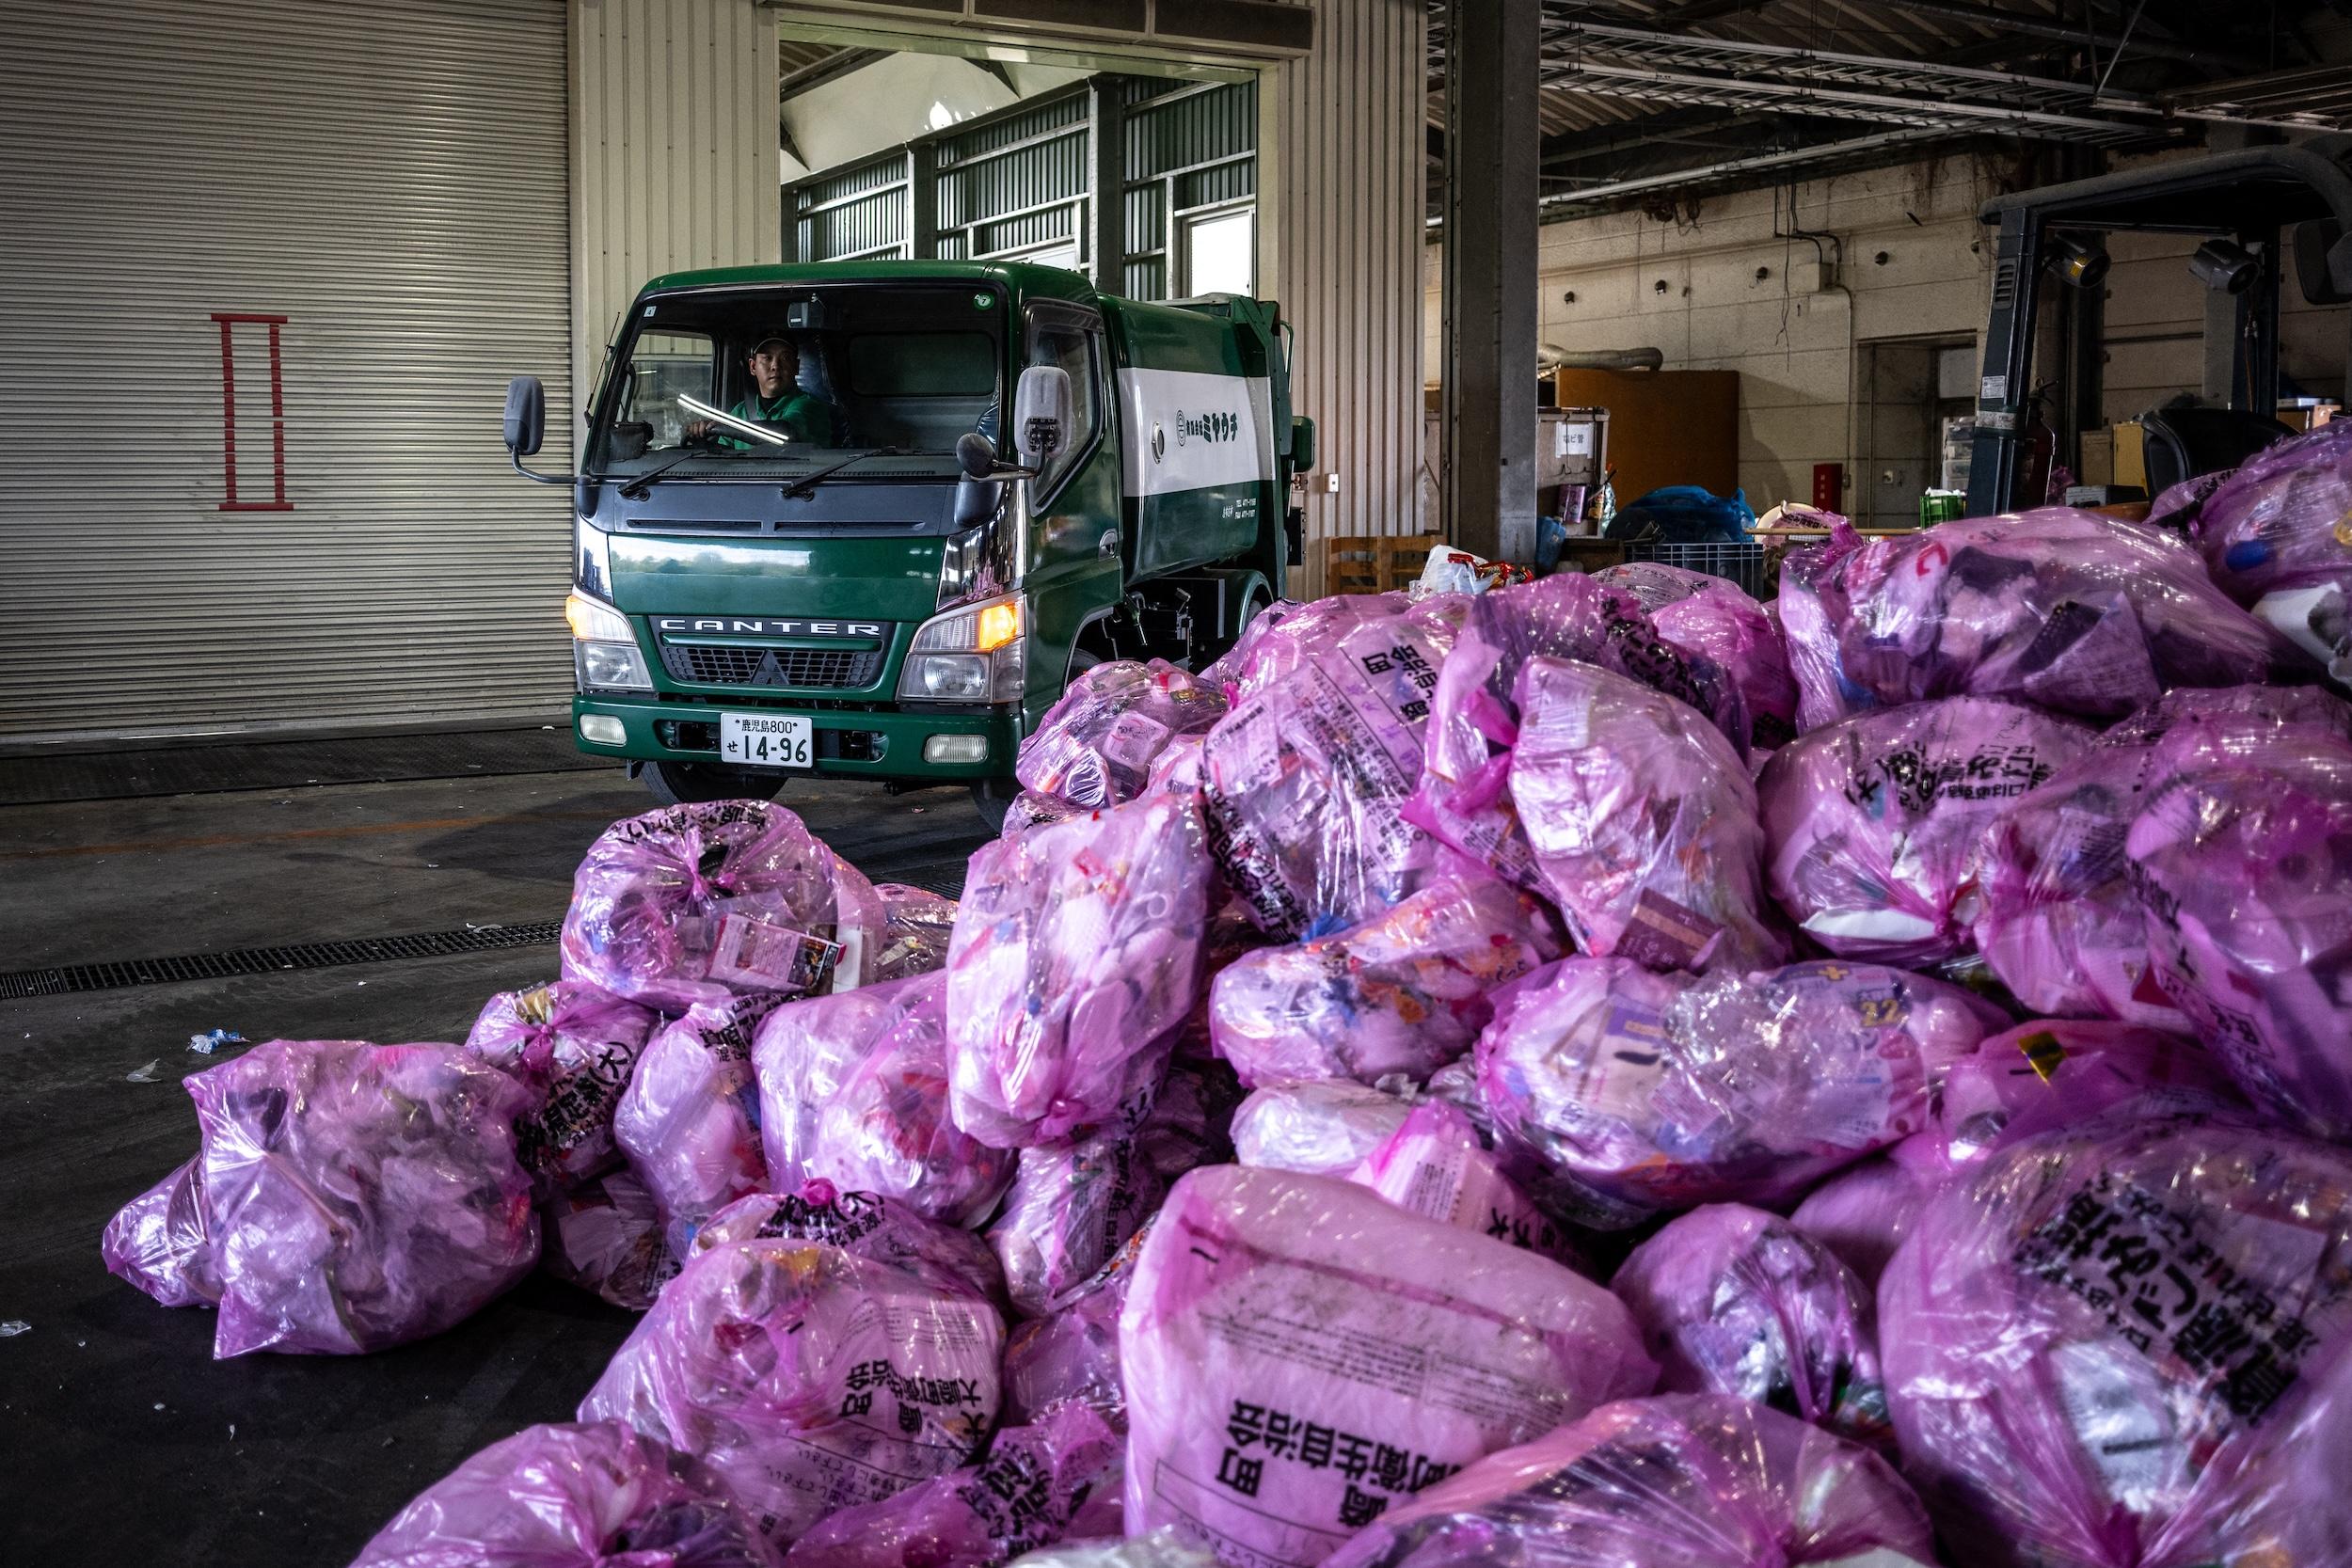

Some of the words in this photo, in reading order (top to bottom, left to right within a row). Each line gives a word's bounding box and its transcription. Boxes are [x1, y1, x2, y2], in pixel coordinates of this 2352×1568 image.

[660, 619, 881, 637] CANTER
[726, 740, 739, 753] せ
[745, 736, 808, 763] 14-96
